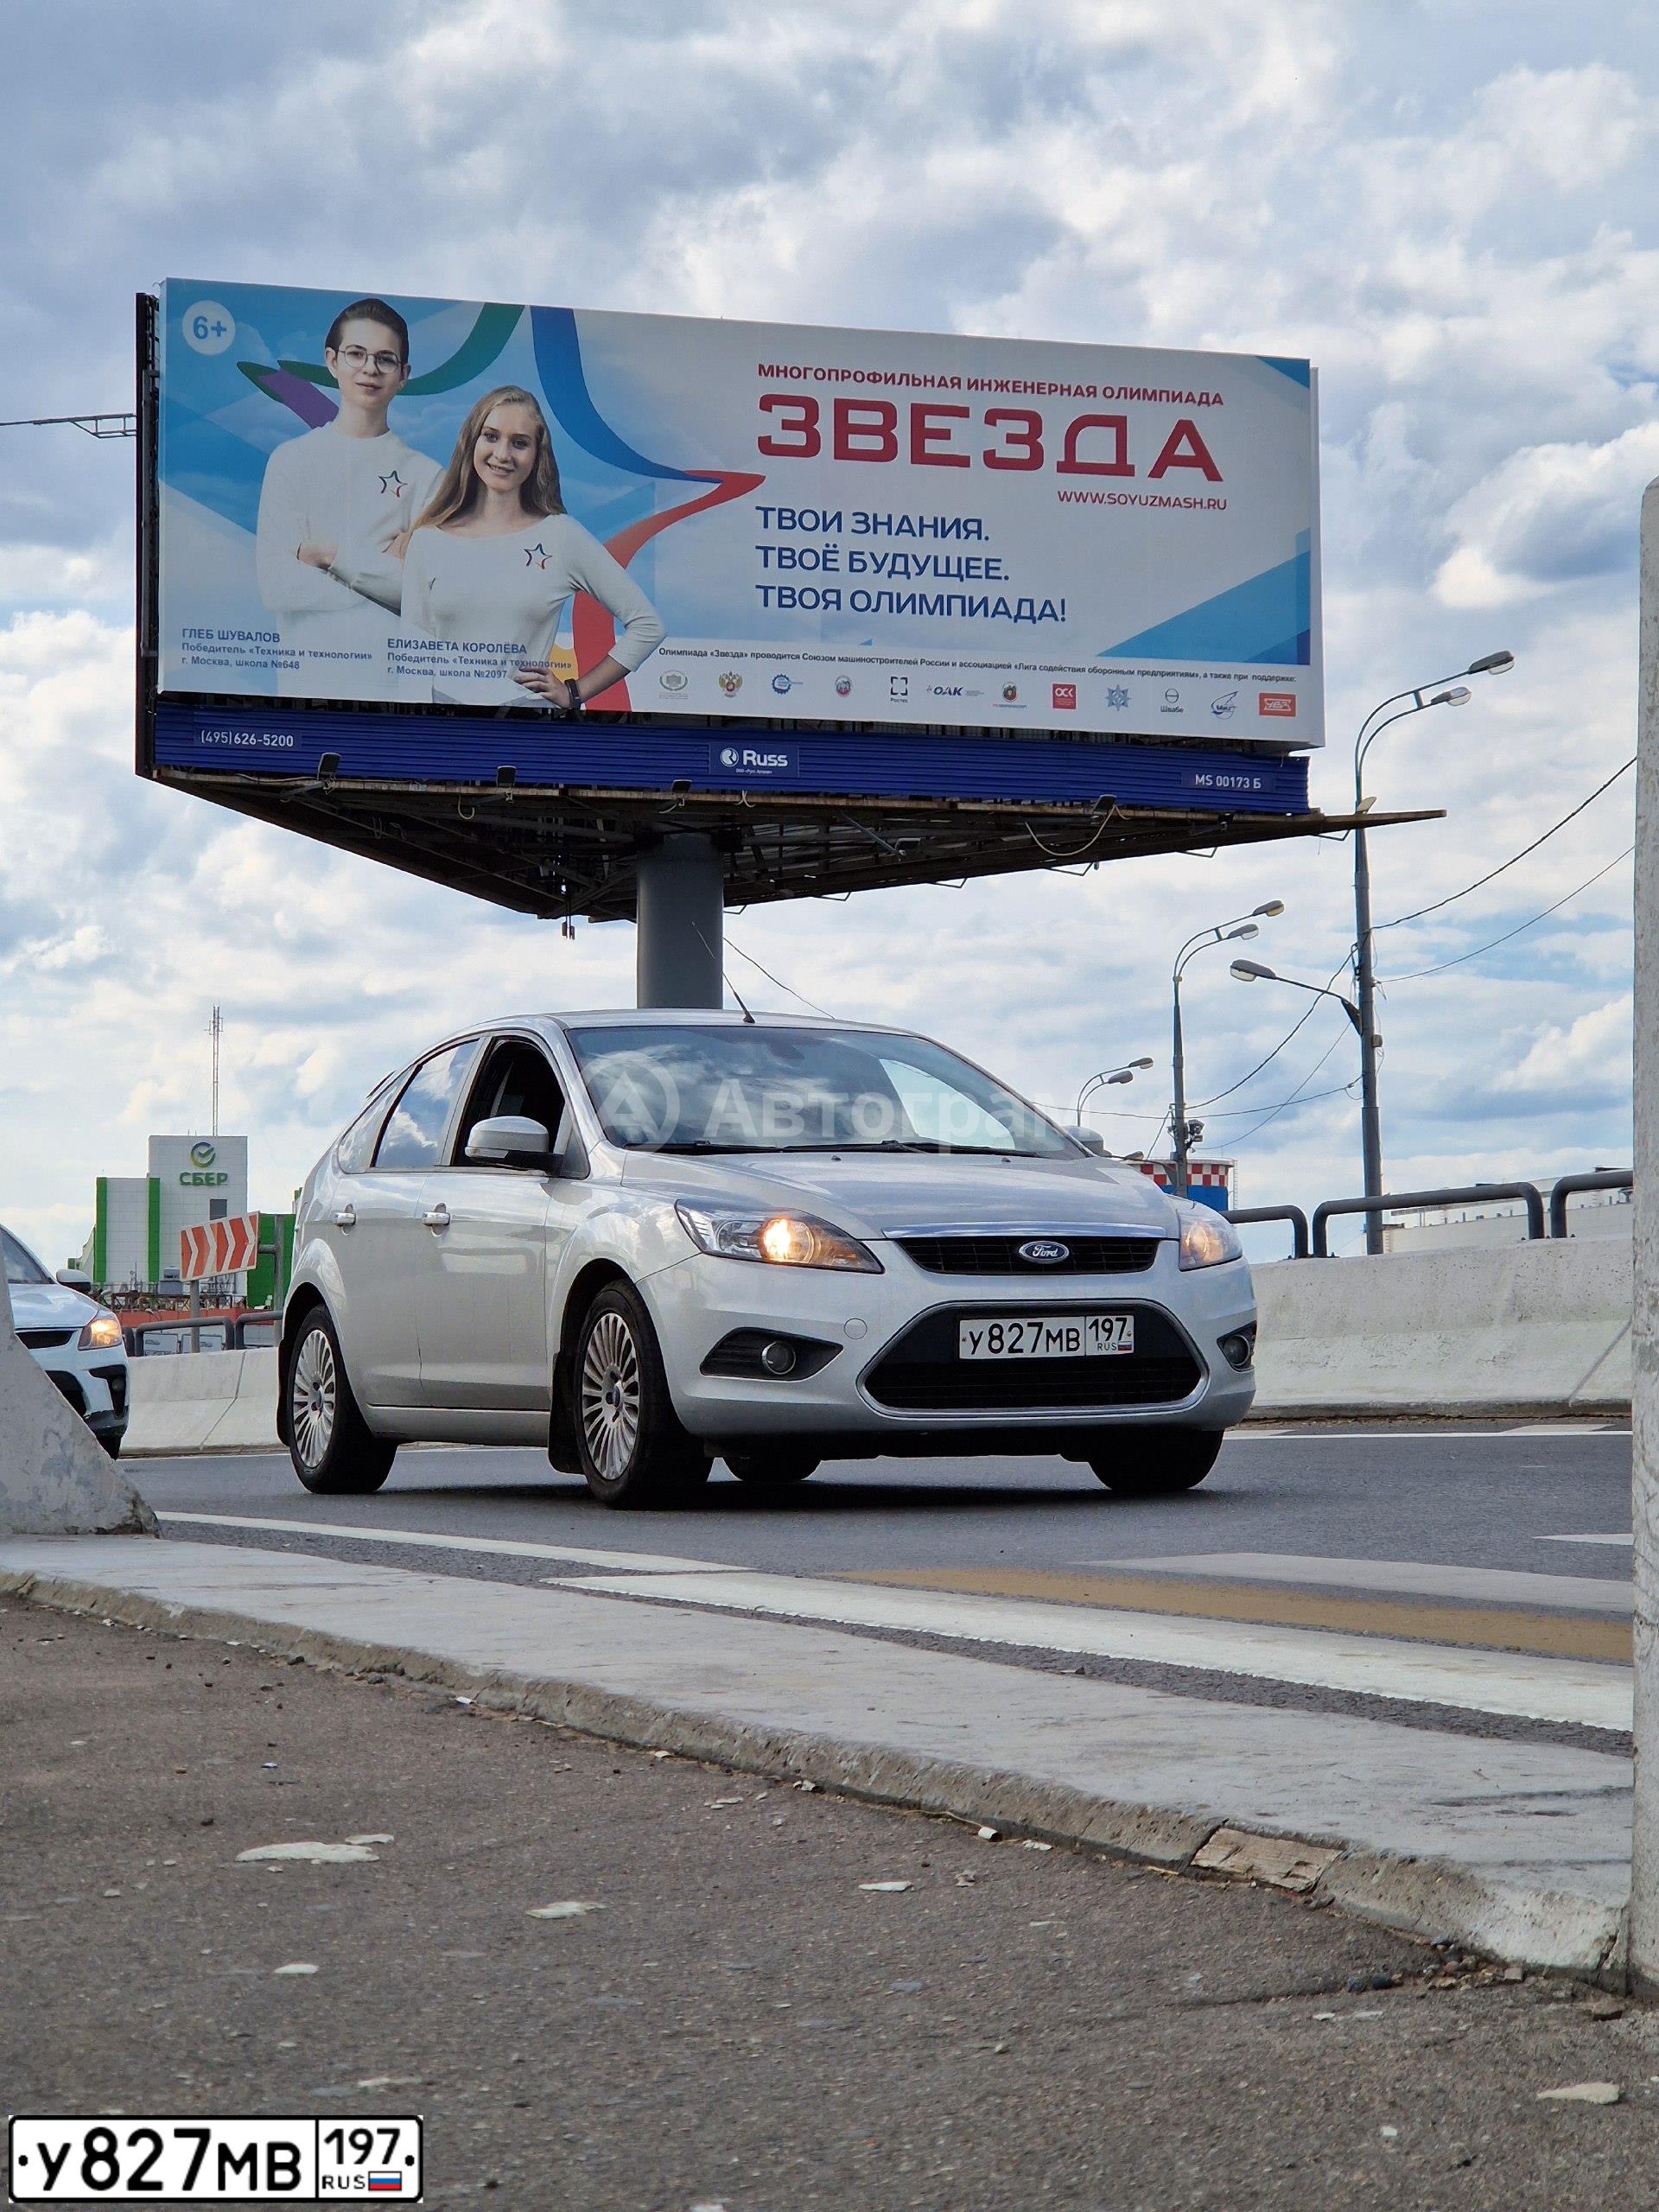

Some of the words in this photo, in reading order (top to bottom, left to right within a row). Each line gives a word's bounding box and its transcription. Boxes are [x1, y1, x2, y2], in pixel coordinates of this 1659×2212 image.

[194, 315, 227, 339] 6+
[758, 364, 962, 390] МНОГОПРОФИЛЬНАЯ
[967, 378, 1097, 398] ИНЖЕНЕРНАЯ
[1103, 386, 1224, 407] ОЛИМПИАДА
[758, 393, 1224, 482] ЗВЕЗДА
[1058, 490, 1227, 511] WWW.SOYUZMASH.RU
[755, 505, 842, 533] ТВОИ
[851, 512, 989, 541] ЗНАНИЯ.
[755, 543, 840, 572] ТВОЁ
[849, 550, 1009, 582] БУДУЩЕЕ.
[755, 584, 842, 611] ТВОЯ
[849, 589, 1065, 624] ОЛИМПИАДА!
[182, 628, 213, 639] ГЛЕБ
[218, 630, 280, 642] ШУВАЛОВ
[182, 643, 245, 654] Победитель
[249, 646, 296, 657] «Техника
[308, 651, 372, 660] технологии»
[388, 639, 459, 652] ЕЛИЗАВЕТА
[462, 641, 527, 654] КОРОЛЁВА
[191, 656, 232, 667] Москва,
[271, 660, 300, 670] №648
[388, 652, 449, 664] Победитель
[453, 656, 498, 666] «Техника
[510, 660, 572, 669] технологии»
[658, 648, 708, 658] Олимпиада
[710, 649, 748, 658] «Звезда»
[751, 652, 800, 662] проводится
[802, 653, 836, 662] Союзом
[838, 657, 918, 666] машиностроителей
[919, 658, 950, 667] России
[959, 660, 1012, 671] ассоциацией
[1039, 664, 1086, 673] содействия
[1088, 666, 1135, 675] оборонным
[1137, 670, 1202, 679] предприятиям»,
[397, 667, 436, 677] Москва,
[474, 669, 507, 678] №2097
[743, 749, 788, 767] Russ
[1195, 773, 1213, 786] MS
[1216, 776, 1249, 788] 00173
[180, 1172, 228, 1186] СБЕР
[1033, 1244, 1058, 1257] Ford
[1088, 1317, 1128, 1342] 197
[1097, 1342, 1116, 1352] RUS
